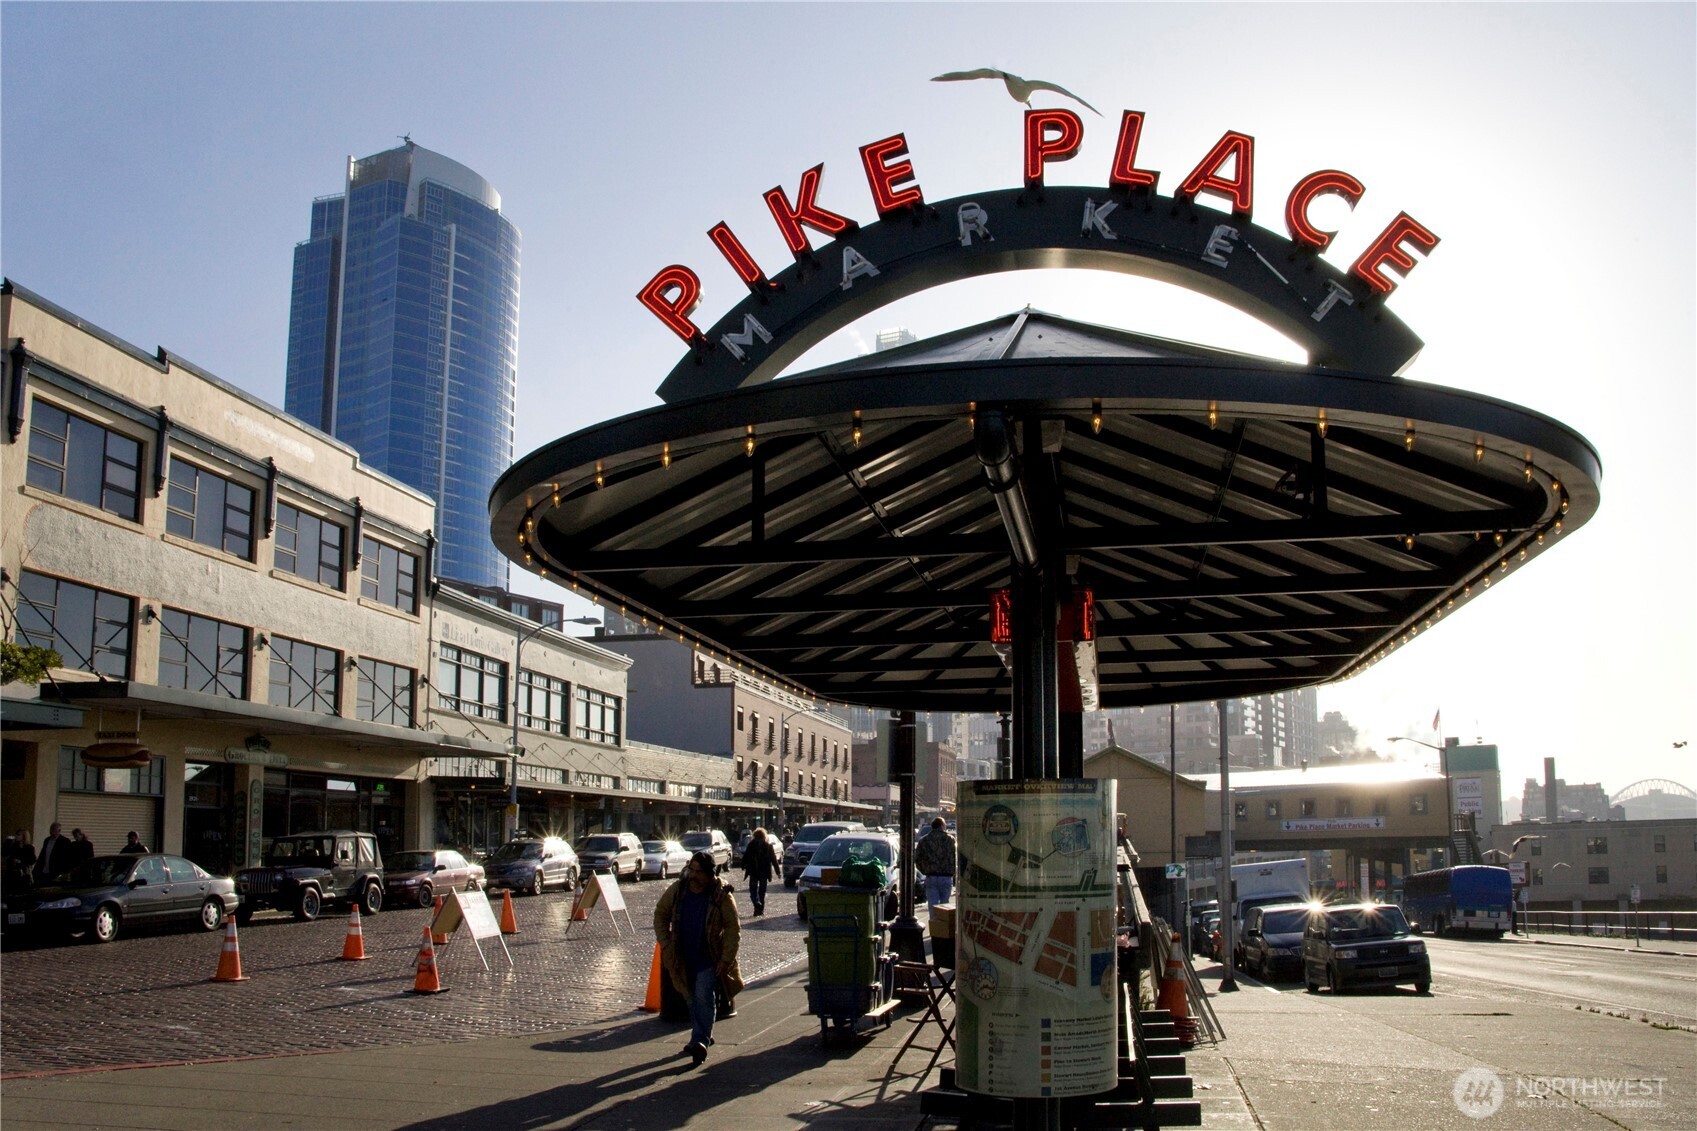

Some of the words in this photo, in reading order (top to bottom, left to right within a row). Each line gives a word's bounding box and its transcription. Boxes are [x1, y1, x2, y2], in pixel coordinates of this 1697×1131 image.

[636, 132, 926, 343] PIKE
[1024, 108, 1441, 297] PLACE
[720, 199, 1356, 364] MARKET
[1326, 822, 1347, 830] Market
[1347, 821, 1370, 829] Parking
